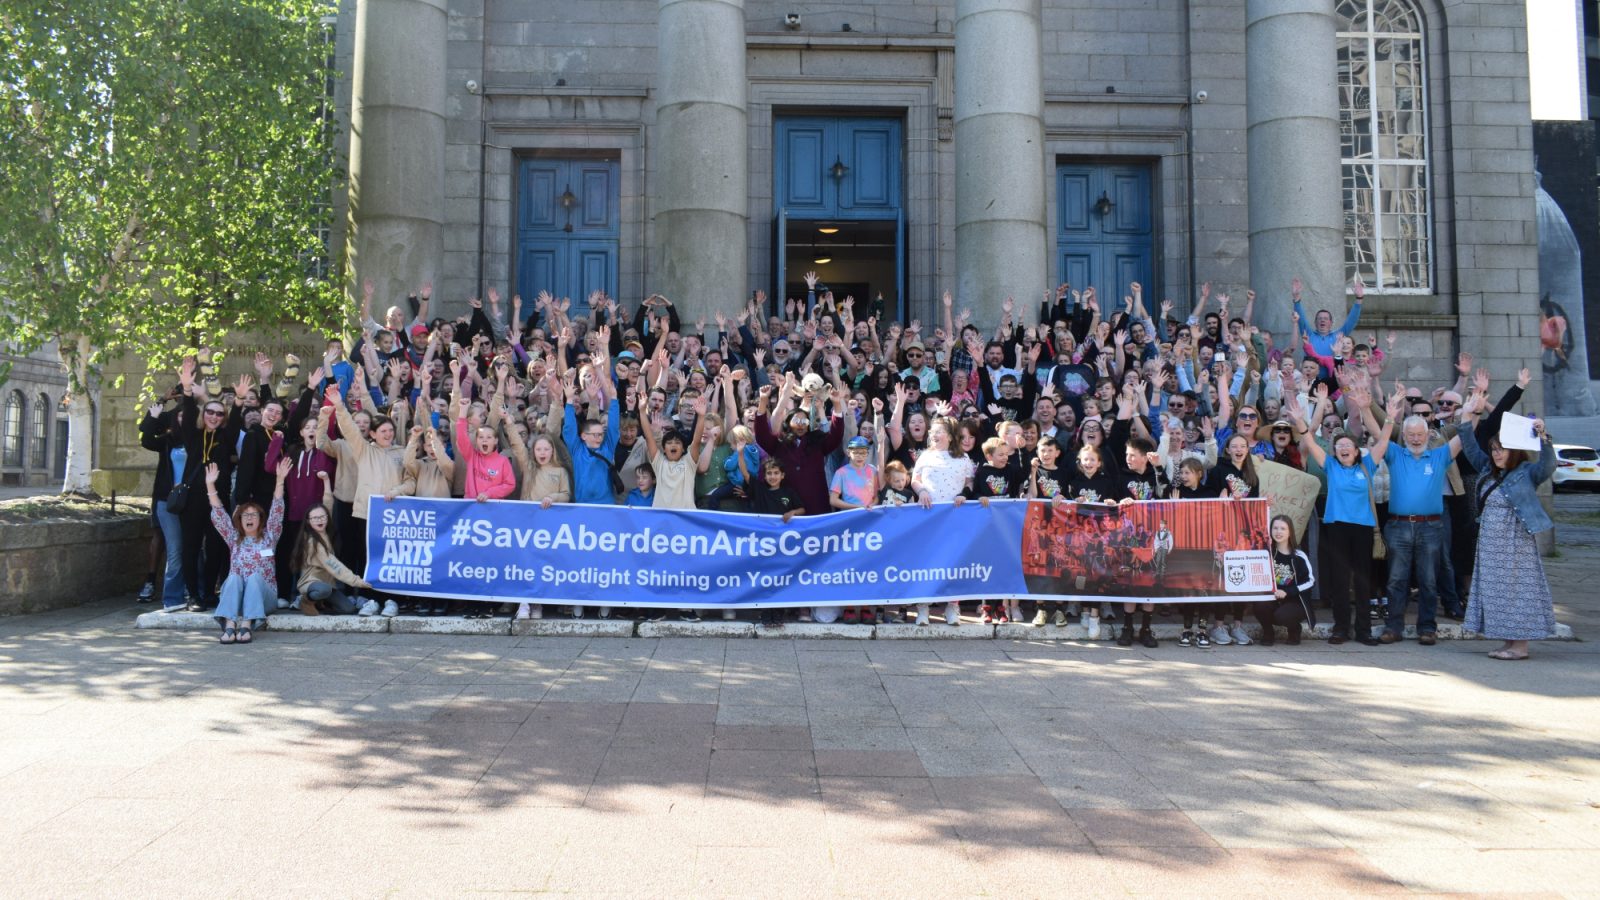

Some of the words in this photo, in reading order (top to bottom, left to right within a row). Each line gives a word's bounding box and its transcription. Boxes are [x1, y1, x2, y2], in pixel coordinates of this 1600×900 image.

[382, 508, 436, 526] SAVE
[382, 526, 436, 540] ABERDEEN
[451, 518, 883, 557] #SaveAberdeenArtsCentre
[382, 540, 435, 566] ARTS
[378, 566, 432, 585] CENTRE
[448, 561, 498, 583] Keep
[504, 565, 535, 581] the
[541, 565, 630, 588] Spotlight
[636, 569, 710, 591] Shining
[716, 575, 741, 587] on
[747, 571, 793, 587] Your
[798, 568, 878, 585] Creative
[884, 563, 993, 583] Community
